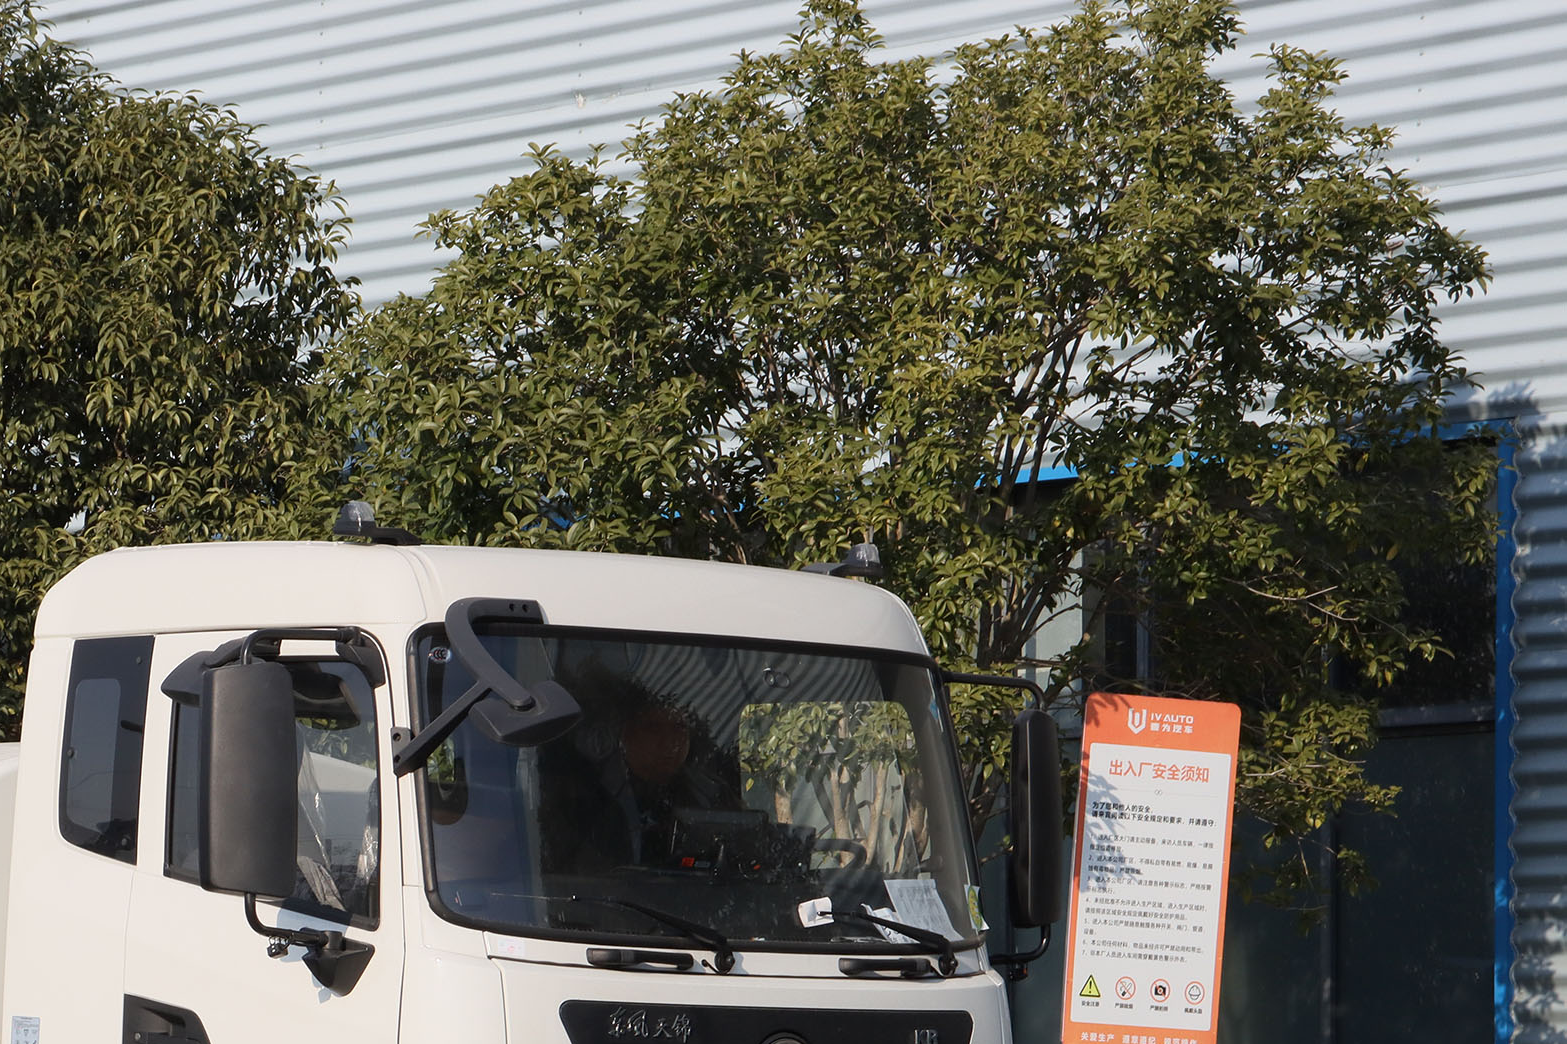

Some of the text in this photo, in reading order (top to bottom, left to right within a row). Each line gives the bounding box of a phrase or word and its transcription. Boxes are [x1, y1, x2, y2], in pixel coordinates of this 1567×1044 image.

[1163, 714, 1194, 724] AUTO
[1109, 760, 1210, 783] 出入厂安全须知
